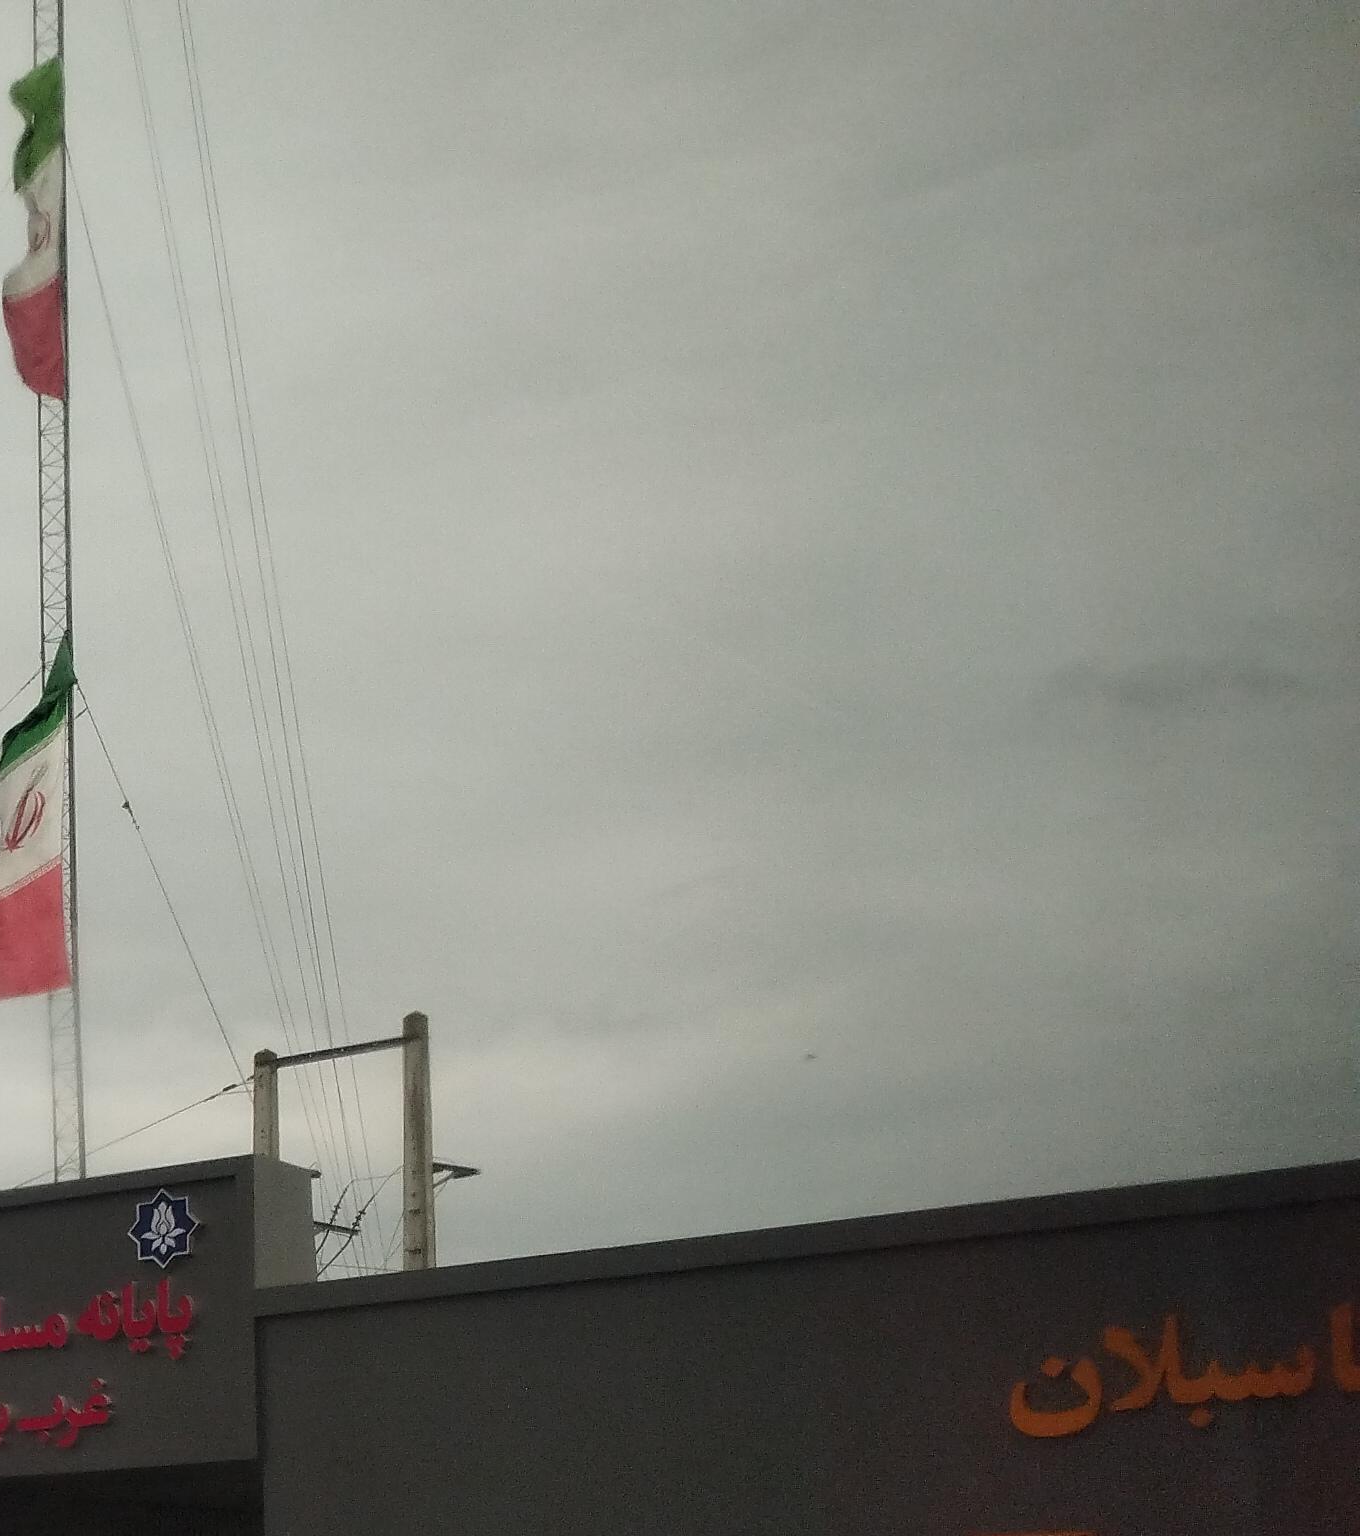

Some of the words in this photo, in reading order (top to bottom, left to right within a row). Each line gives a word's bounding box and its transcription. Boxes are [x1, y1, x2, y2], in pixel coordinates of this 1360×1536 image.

[76, 1276, 194, 1358] پایانه
[16, 1378, 112, 1448] غرب
[1009, 1312, 1314, 1437] سبلان
